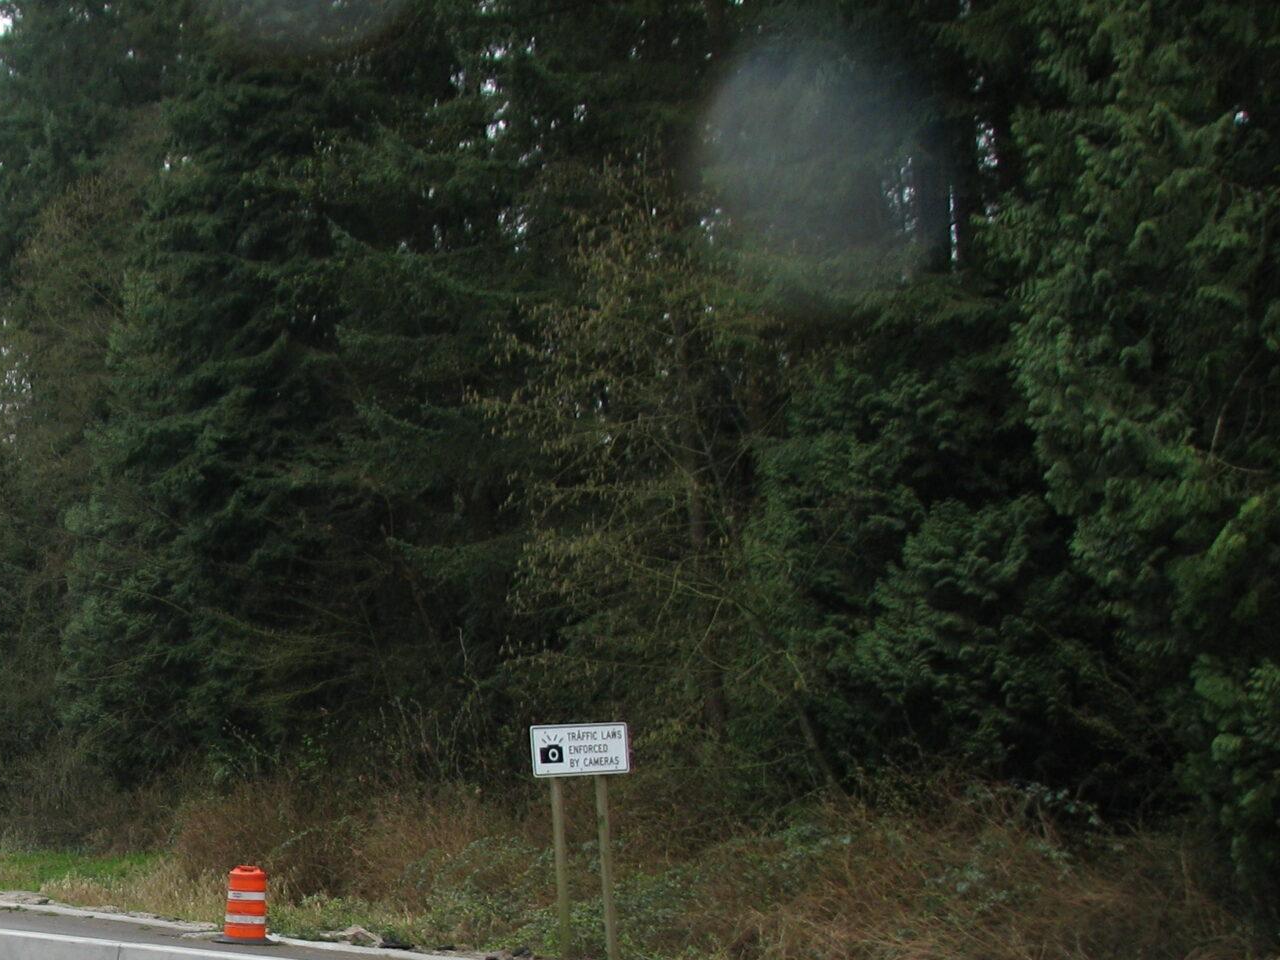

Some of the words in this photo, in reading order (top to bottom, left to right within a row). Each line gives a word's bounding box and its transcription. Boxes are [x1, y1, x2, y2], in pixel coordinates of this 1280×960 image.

[567, 730, 598, 742] TRAFFIC
[601, 729, 622, 740] LAWS
[568, 744, 608, 755] ENFORCED
[570, 758, 580, 768] BY
[583, 756, 620, 767] CAMERAS
